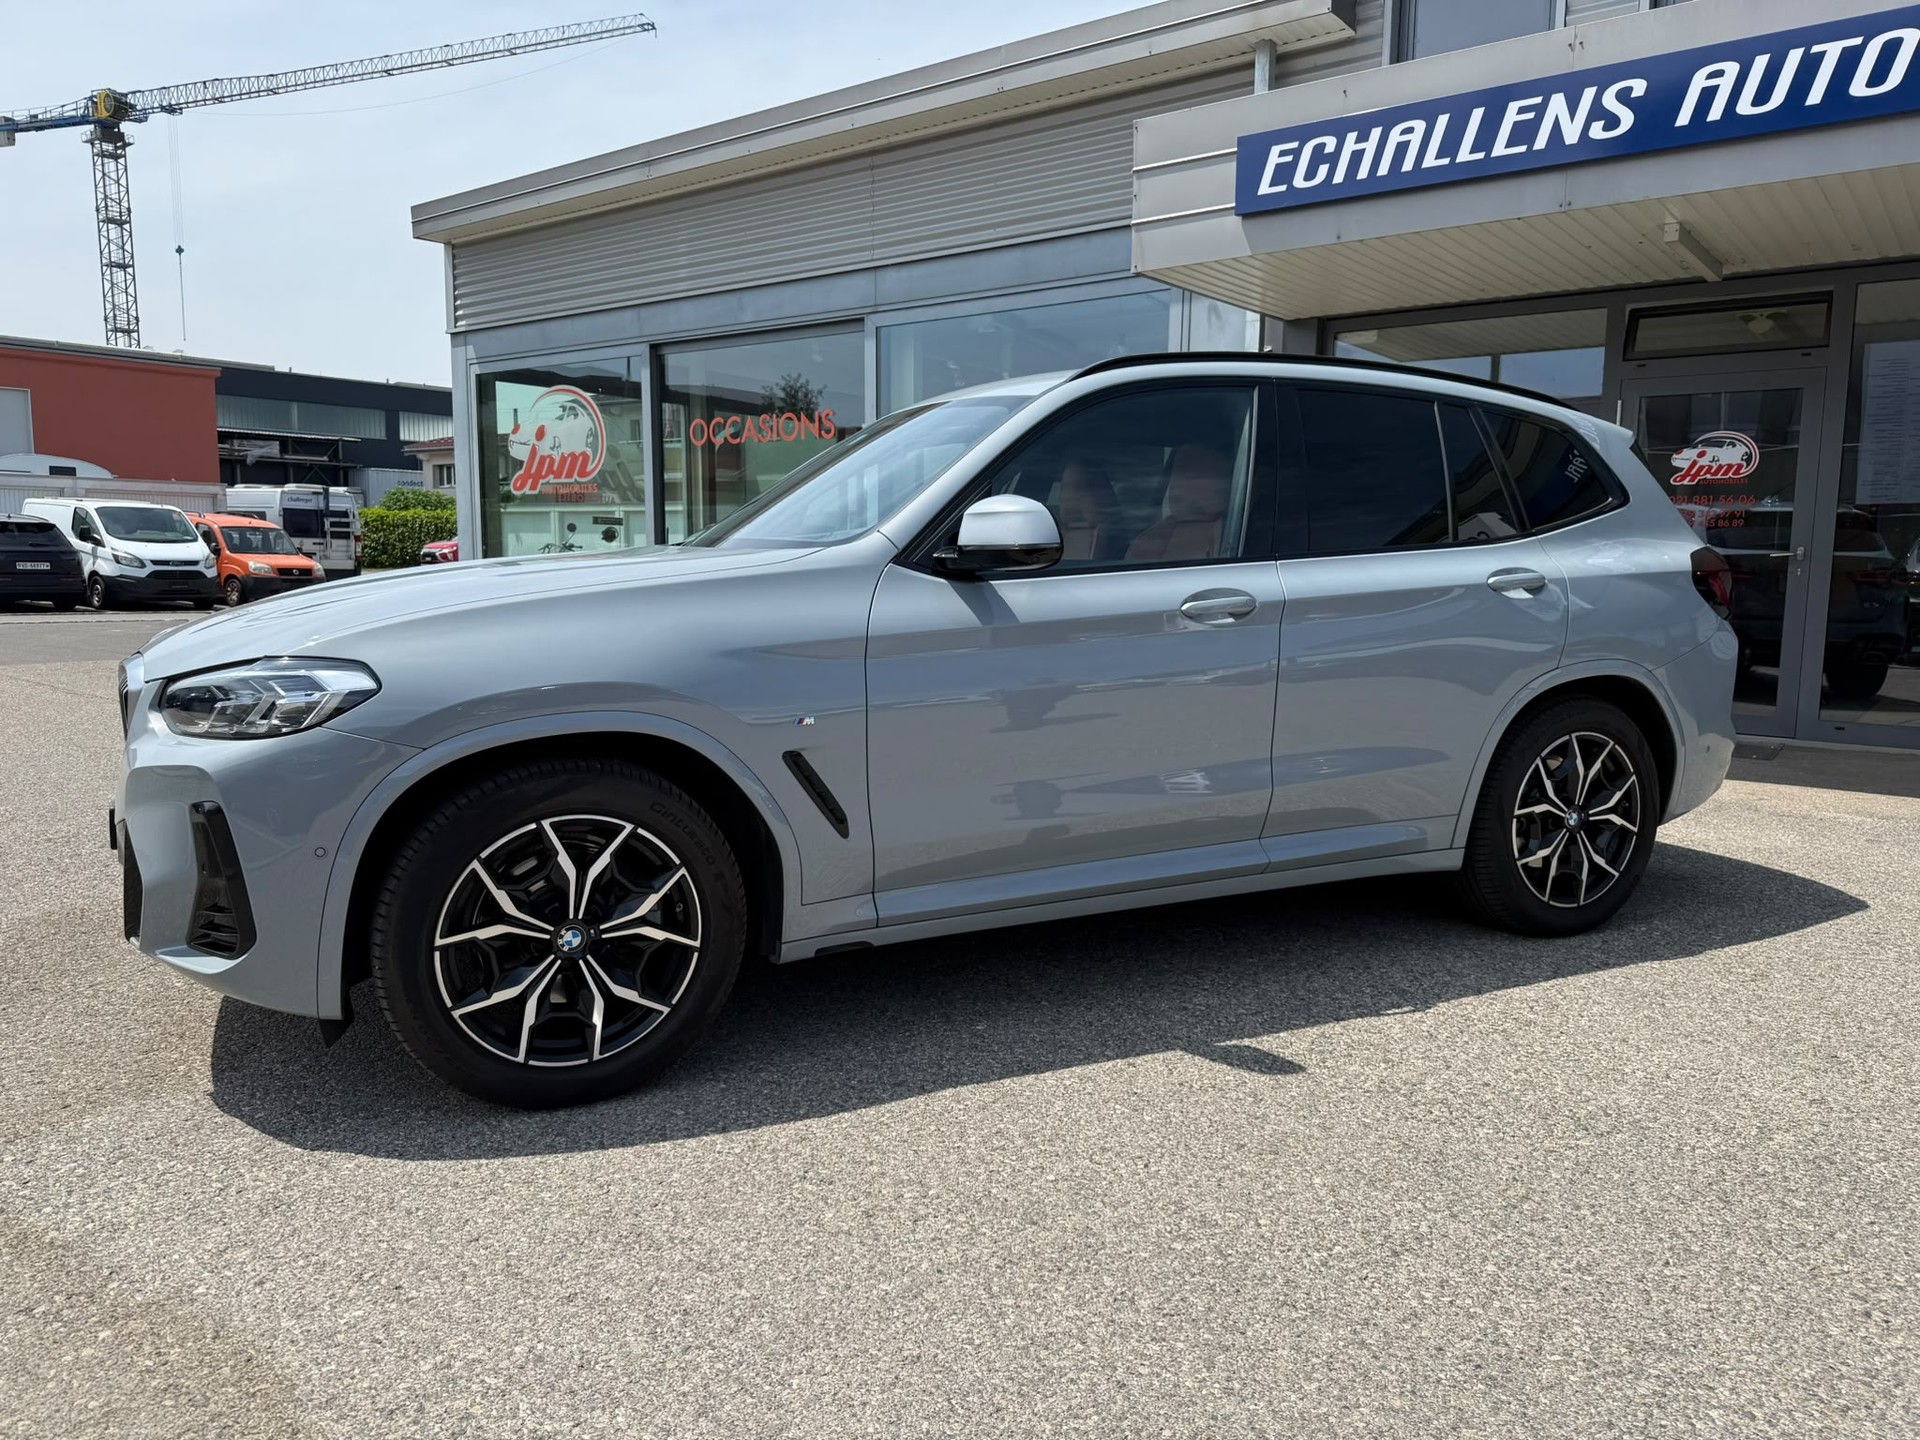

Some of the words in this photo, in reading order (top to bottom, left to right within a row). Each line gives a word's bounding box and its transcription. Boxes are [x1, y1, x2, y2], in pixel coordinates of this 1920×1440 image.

[1256, 77, 1648, 196] ECHALLENS
[1674, 27, 1920, 127] AUTO
[689, 408, 836, 447] OCCASIONS
[511, 424, 594, 494] jpm
[1670, 450, 1746, 485] jpm
[1719, 495, 1734, 506] 56
[1738, 494, 1757, 506] 06
[1717, 520, 1730, 528] 86
[1731, 520, 1745, 528] 89
